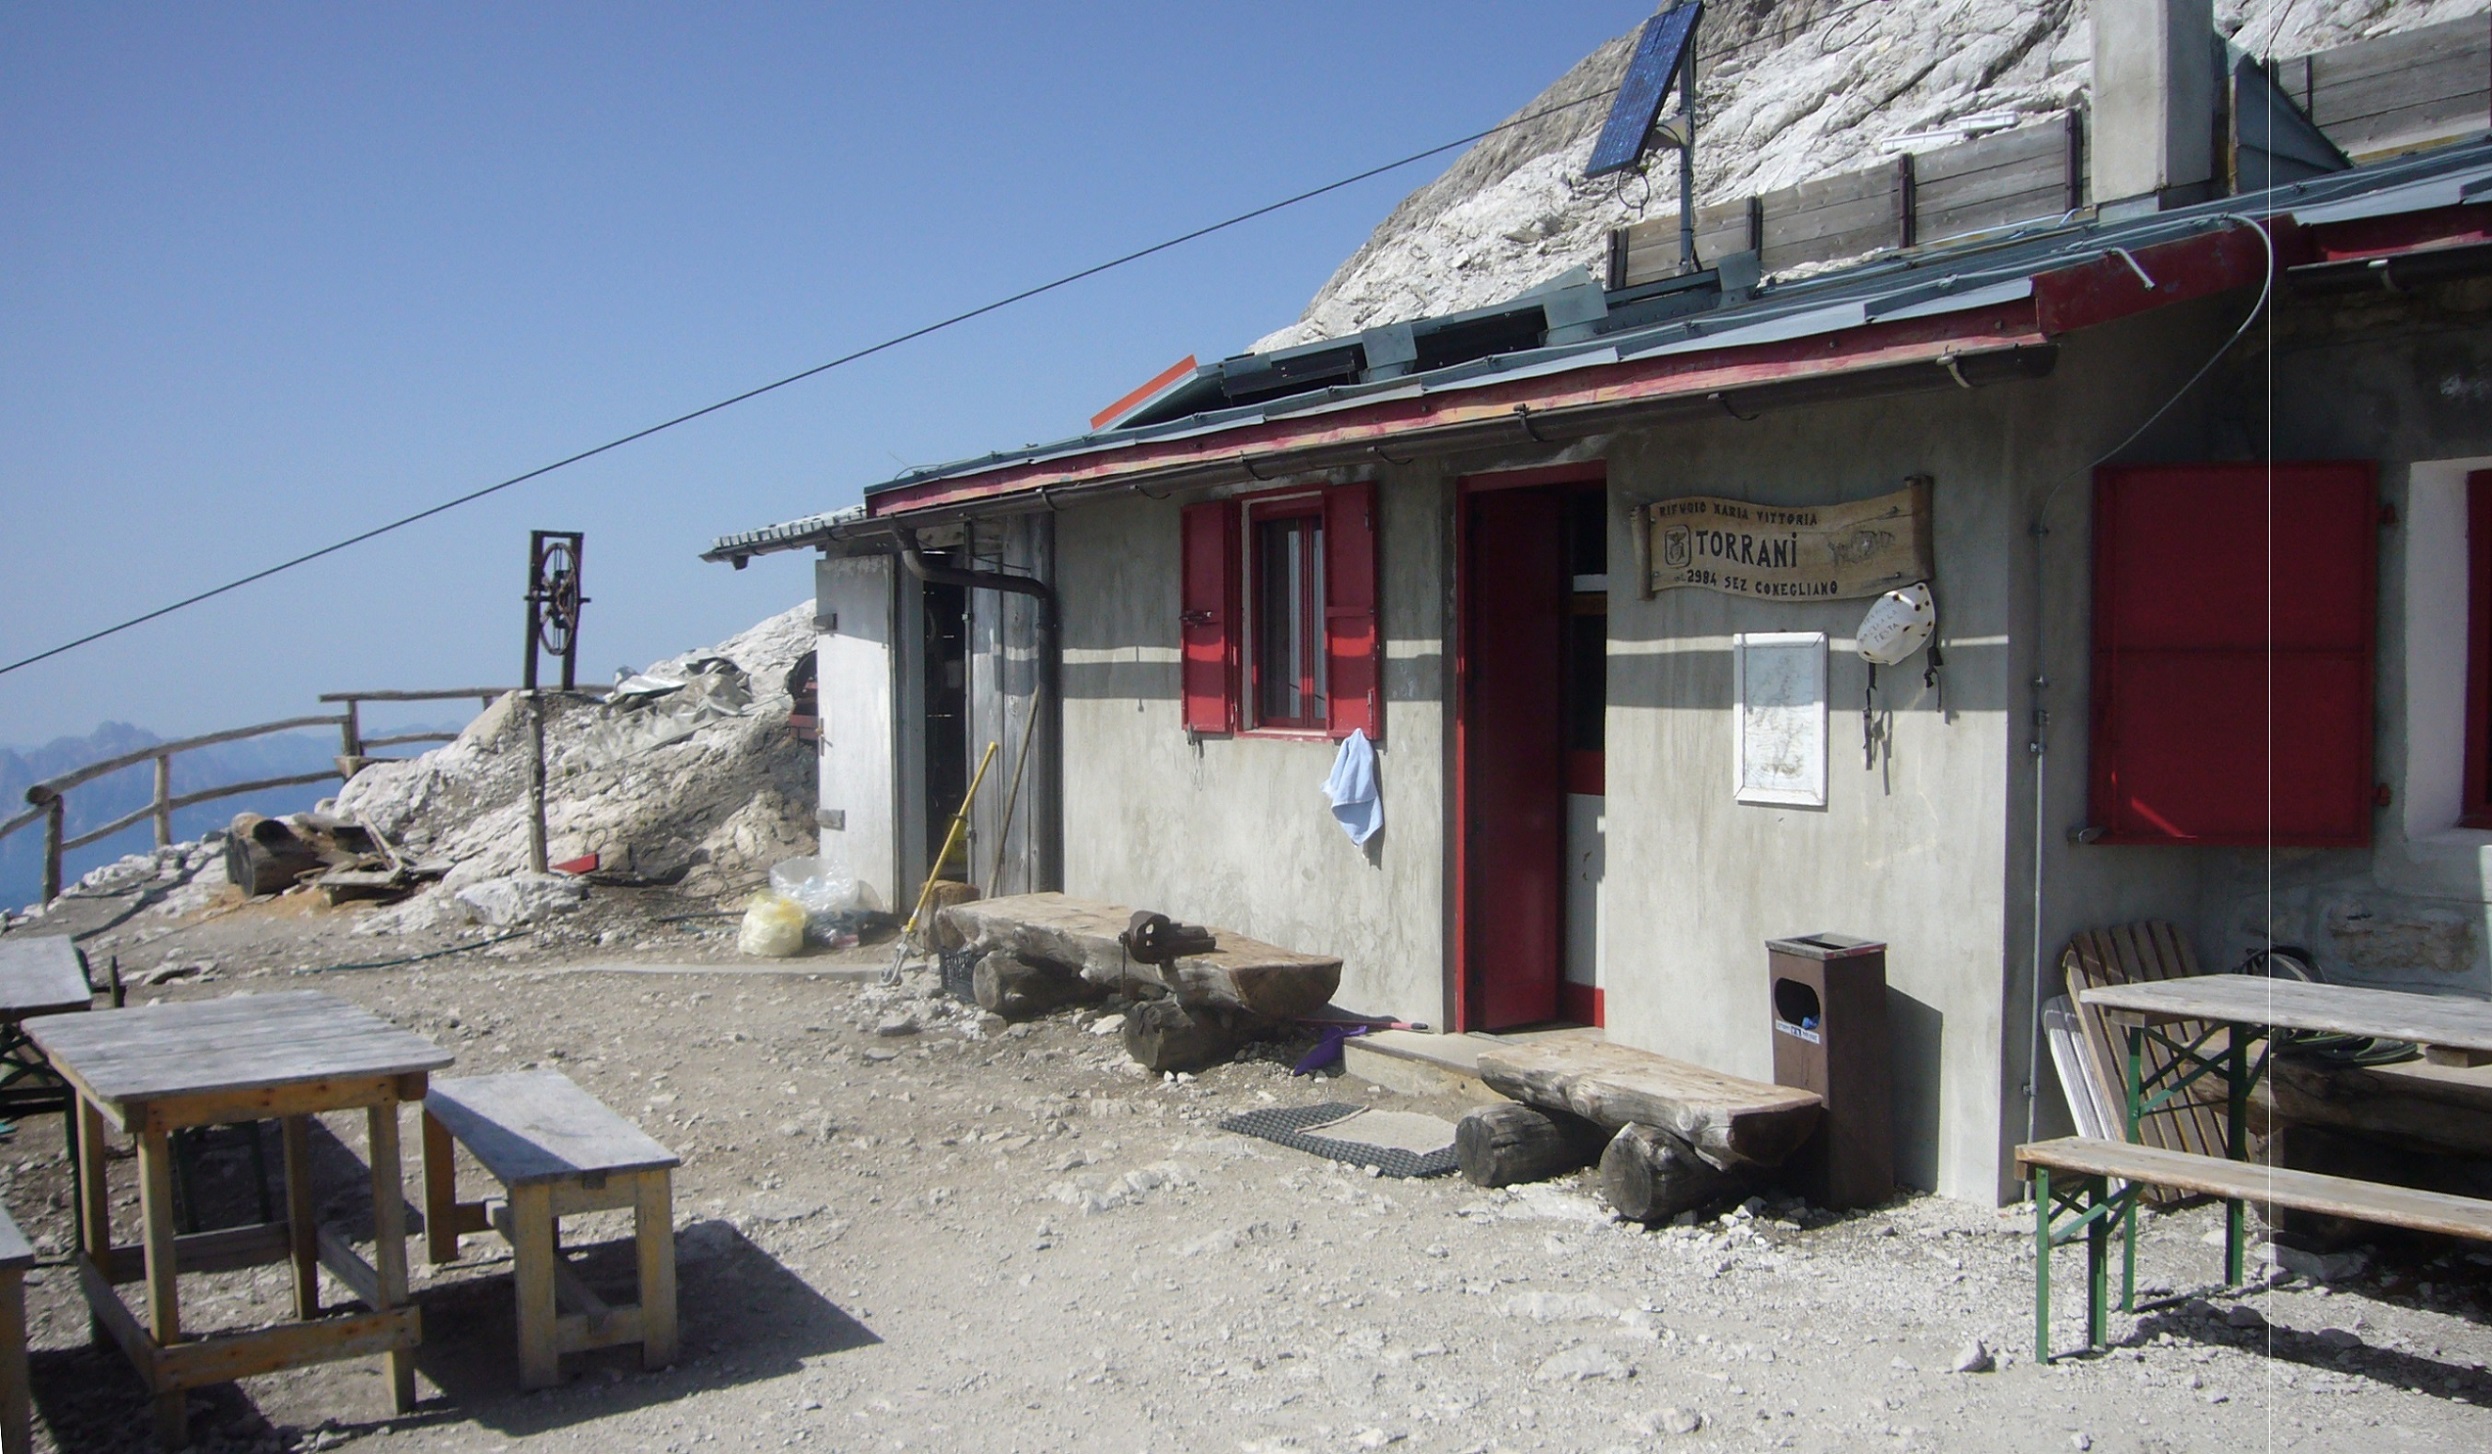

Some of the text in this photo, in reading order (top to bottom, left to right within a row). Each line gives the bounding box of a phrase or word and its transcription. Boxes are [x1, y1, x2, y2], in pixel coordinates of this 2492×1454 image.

[1659, 501, 1818, 525] RIFUGIO MARIA VITTORIA
[1687, 569, 1717, 586] 2984
[1724, 576, 1747, 590] SEZ
[1755, 579, 1838, 596] CONEGLIANO
